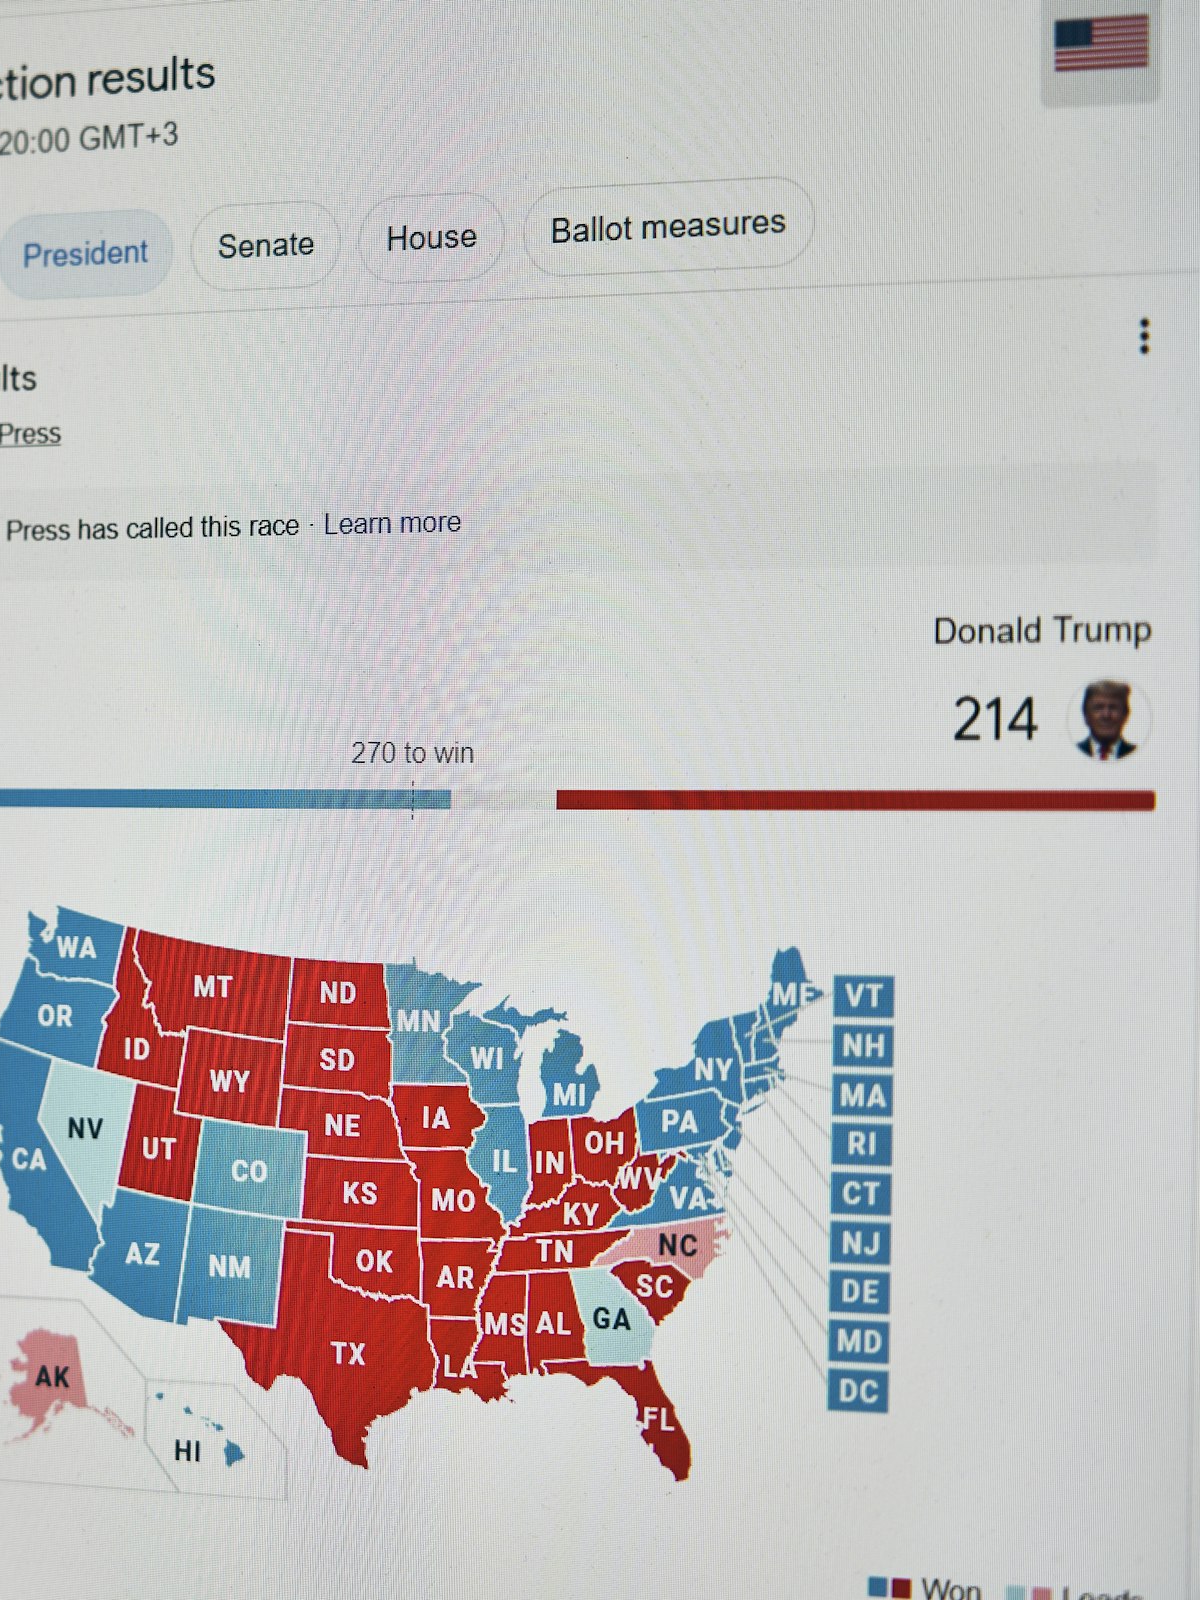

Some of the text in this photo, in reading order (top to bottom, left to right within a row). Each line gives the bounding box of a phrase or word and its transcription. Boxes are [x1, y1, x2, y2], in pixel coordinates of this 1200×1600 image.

[88, 56, 215, 95] results
[79, 121, 178, 150] GMT+3
[388, 225, 477, 251] House
[552, 214, 786, 243] Ballot measures
[24, 240, 148, 267] President
[219, 233, 314, 259] Senate
[7, 520, 71, 541] Press
[78, 519, 119, 540] has
[126, 516, 193, 539] called
[201, 516, 241, 537] this
[250, 519, 299, 536] race
[325, 513, 391, 535] Learn
[401, 515, 461, 533] more
[935, 615, 1152, 649] Donald Trump
[954, 696, 1037, 740] 214
[352, 741, 474, 764] 270 to win
[57, 936, 96, 958] WA
[194, 975, 233, 997] MT
[321, 981, 356, 1003] ND
[773, 982, 813, 1005] ME
[846, 983, 883, 1007] VT
[38, 1004, 72, 1027] OR
[398, 1010, 440, 1032] MN
[125, 1038, 149, 1060] ID
[843, 1033, 884, 1057] NH
[320, 1048, 354, 1071] SD
[471, 1047, 502, 1069] WI
[695, 1057, 732, 1081] NY
[210, 1070, 249, 1092] WY
[554, 1083, 585, 1106] MI
[841, 1083, 886, 1107] MA
[69, 1118, 103, 1139] NV
[325, 1114, 359, 1137] NE
[423, 1106, 450, 1129] IA
[662, 1109, 698, 1133] PA
[143, 1137, 176, 1160] UT
[585, 1131, 623, 1154] OH
[848, 1131, 875, 1155] RI
[12, 1147, 46, 1170] CA
[493, 1149, 517, 1172] IL
[536, 1151, 564, 1174] IN
[232, 1160, 267, 1183] CO
[621, 1167, 663, 1190] WV
[344, 1181, 377, 1204] KS
[432, 1188, 475, 1212] MO
[670, 1187, 708, 1210] VA
[843, 1181, 880, 1205] CT
[564, 1202, 598, 1225] KY
[126, 1242, 160, 1265] AZ
[536, 1239, 573, 1263] TN
[659, 1233, 697, 1257] NC
[843, 1231, 879, 1255] NJ
[210, 1255, 250, 1278] NM
[356, 1249, 392, 1273] OK
[437, 1265, 473, 1289] AR
[637, 1275, 674, 1298] SC
[842, 1279, 878, 1303] DE
[485, 1312, 525, 1336] MS
[536, 1311, 571, 1335] AL
[593, 1307, 631, 1330] GA
[838, 1329, 881, 1353] MD
[331, 1341, 365, 1365] TX
[36, 1366, 69, 1388] AK
[443, 1355, 478, 1379] LA
[840, 1378, 878, 1403] DC
[644, 1407, 675, 1432] FL
[175, 1440, 200, 1462] HI
[922, 1578, 981, 1600] Won
